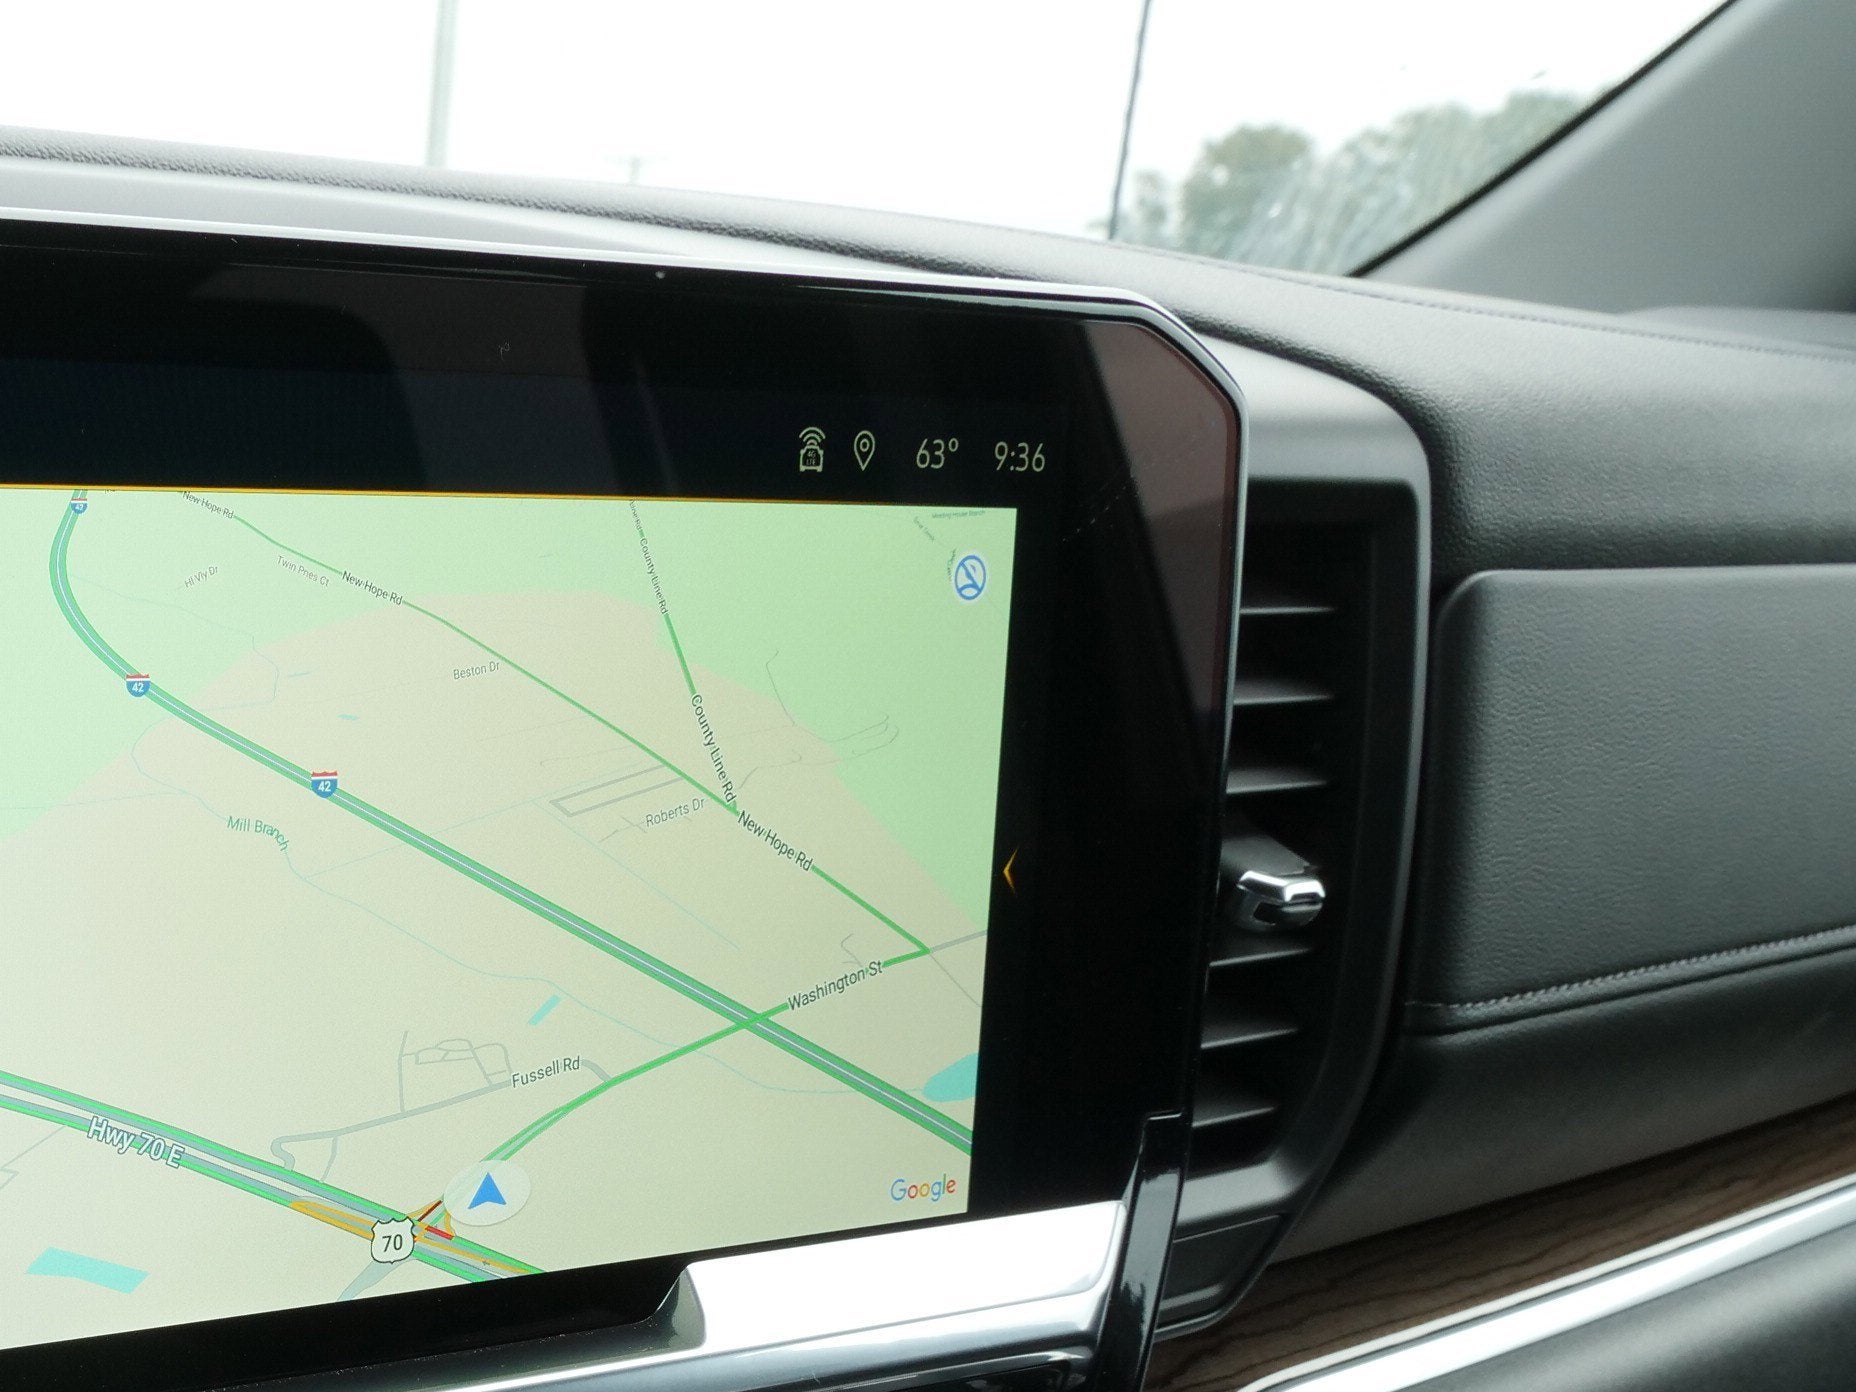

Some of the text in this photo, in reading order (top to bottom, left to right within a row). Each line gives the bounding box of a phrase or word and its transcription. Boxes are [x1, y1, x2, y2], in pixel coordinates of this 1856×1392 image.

[915, 437, 960, 470] 63°
[994, 441, 1045, 472] 9:36
[342, 570, 403, 606] New Hope Rd
[639, 537, 656, 575] County
[658, 598, 669, 615] Rd
[453, 660, 501, 680] Beston Dr
[691, 693, 737, 803] County Line Rd
[317, 779, 332, 793] 42
[645, 797, 705, 828] Roberts Dr
[226, 815, 290, 852] Mill Branch
[737, 809, 813, 871] New Hope Rd
[788, 959, 883, 1011] Washington St
[511, 1055, 581, 1089] Fussell Rd
[86, 1114, 185, 1169] Hwy 70 E
[890, 1173, 957, 1203] Google
[381, 1233, 404, 1252] 70
